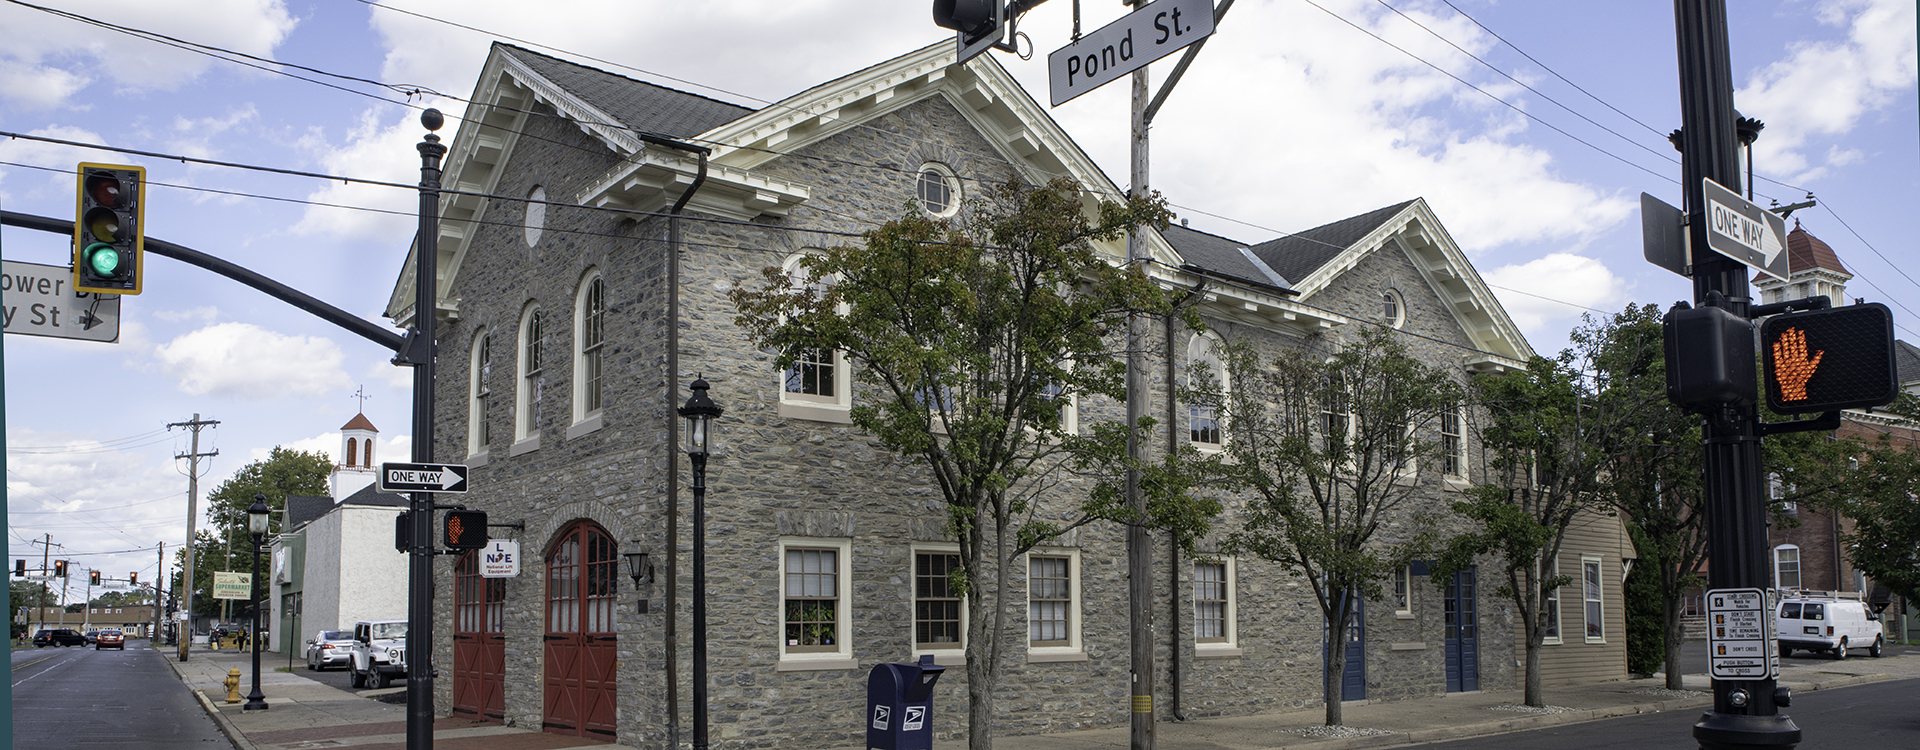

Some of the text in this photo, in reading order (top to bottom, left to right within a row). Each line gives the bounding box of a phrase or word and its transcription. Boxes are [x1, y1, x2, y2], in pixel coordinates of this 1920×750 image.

[1068, 6, 1191, 87] Pond St.
[1715, 206, 1764, 250] ONE WAY
[30, 303, 60, 327] St
[391, 471, 442, 483] ONE WAY
[496, 543, 504, 552] L
[486, 554, 512, 563] N E
